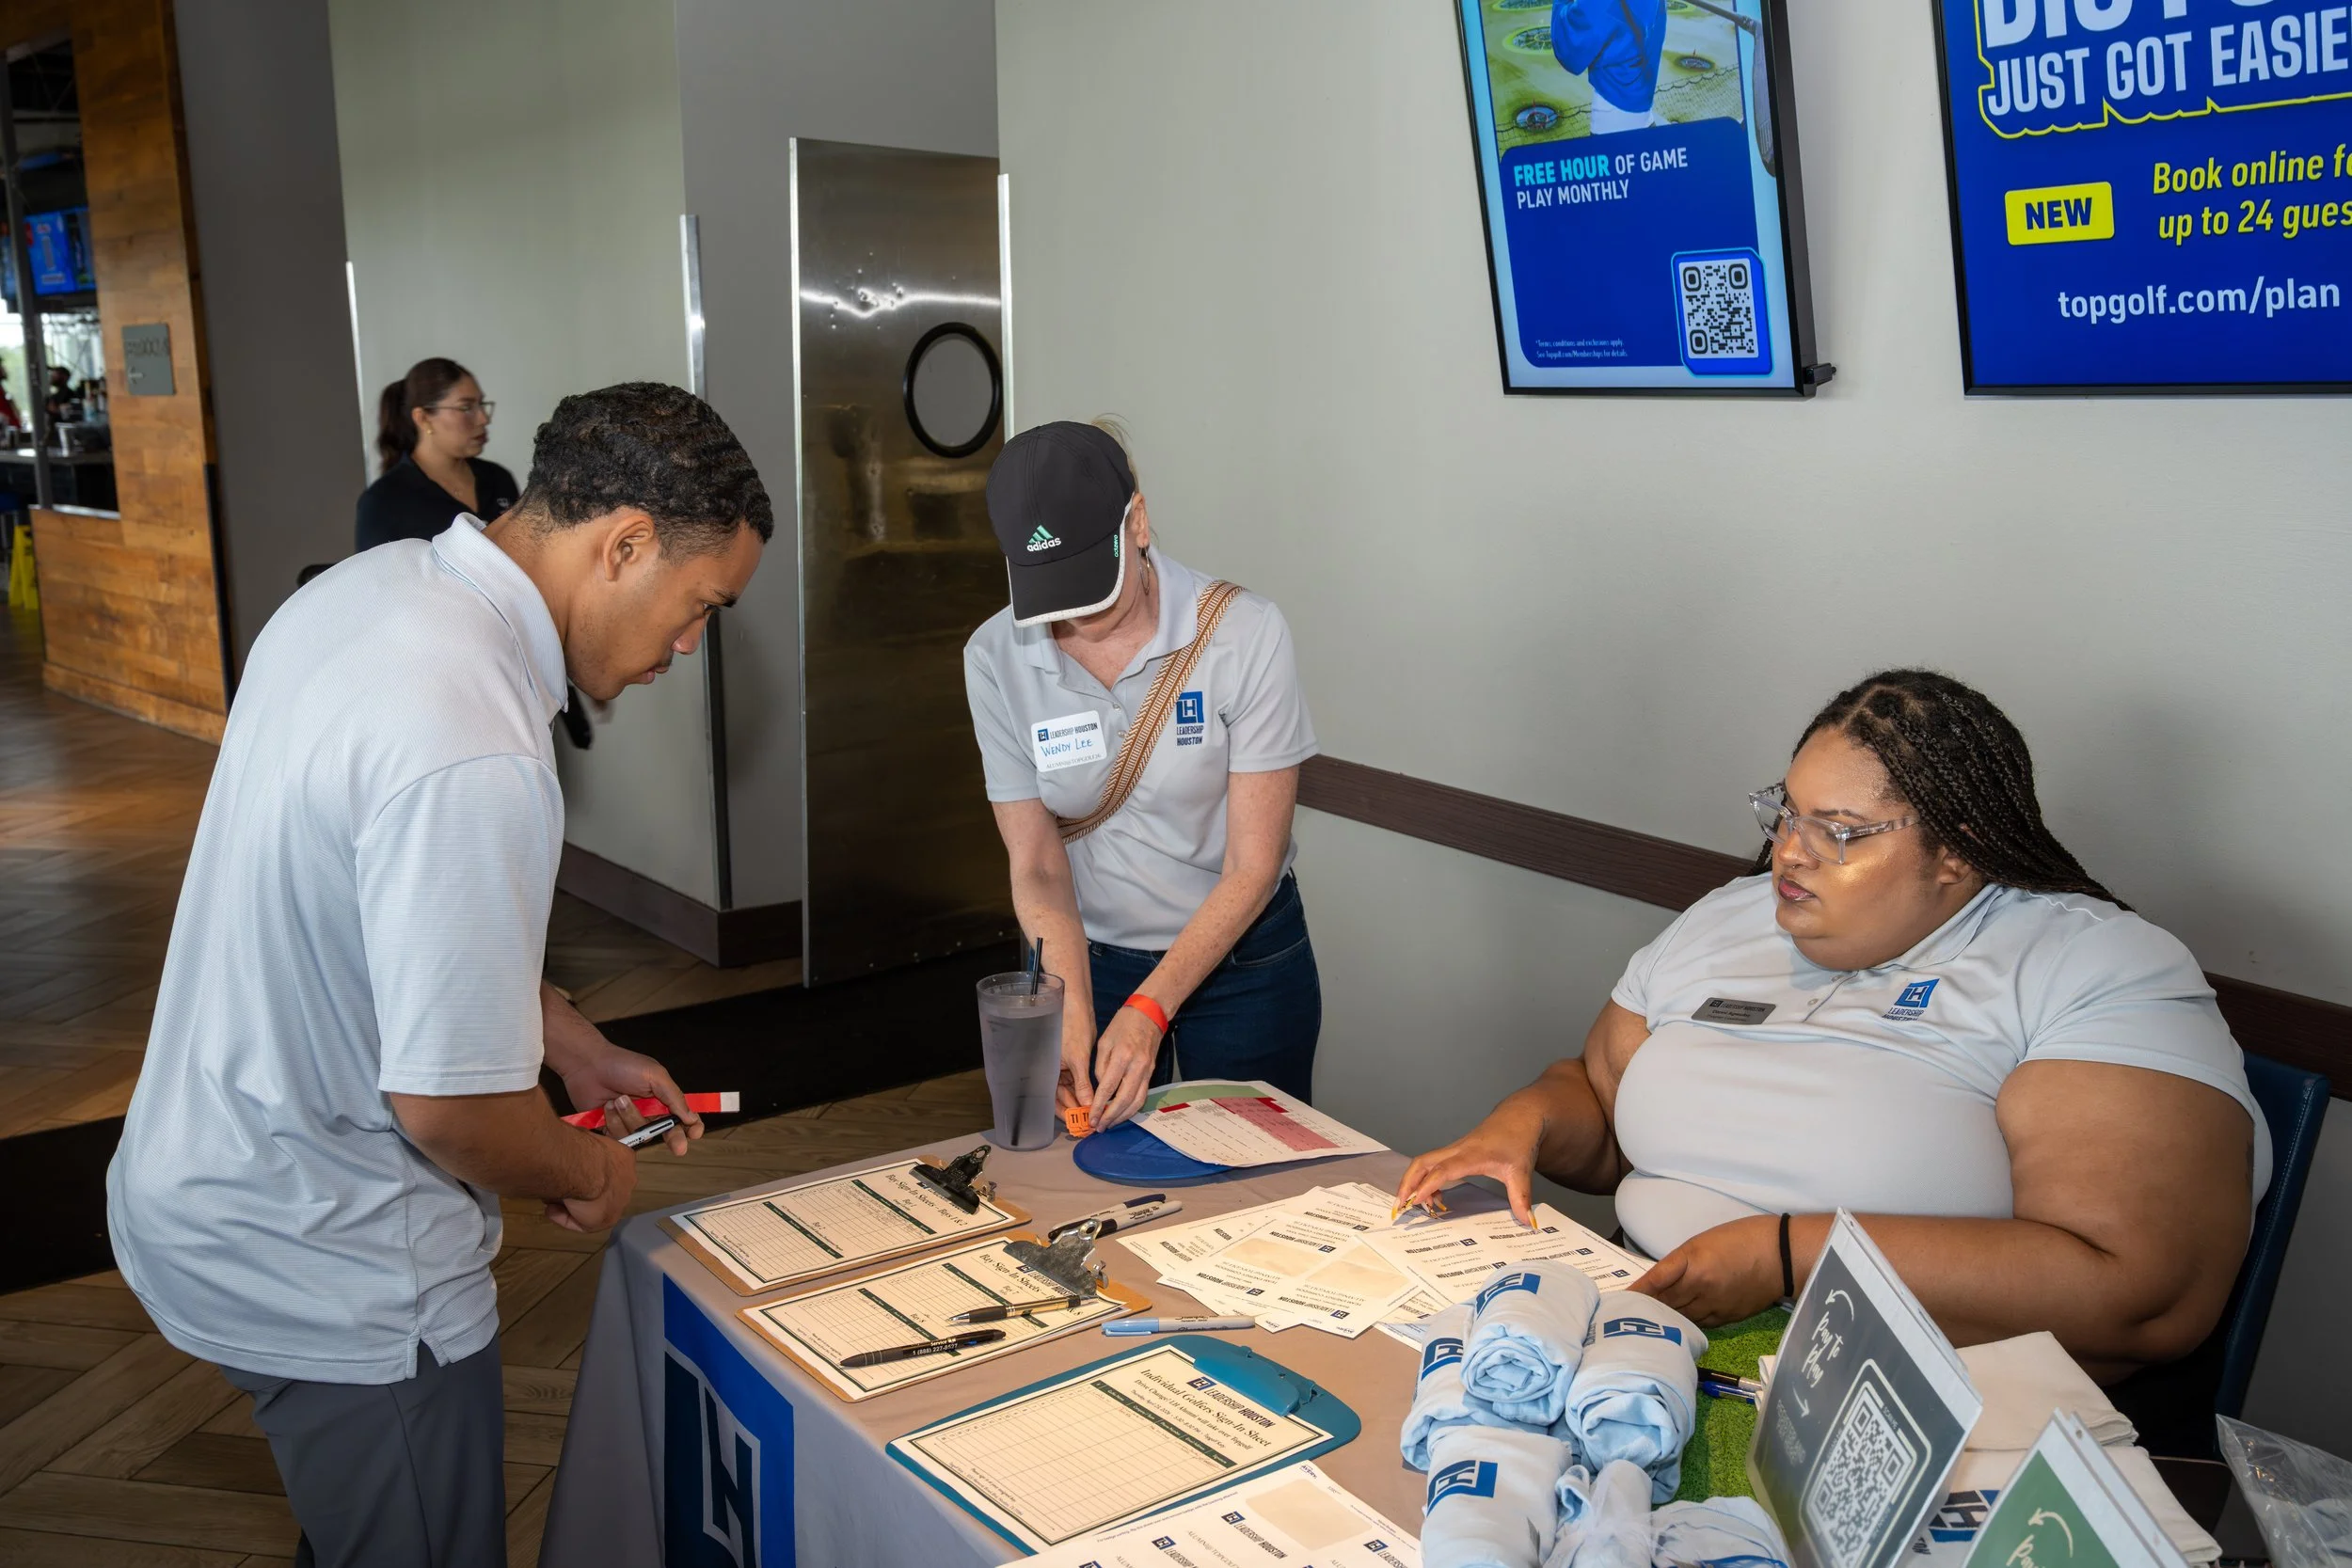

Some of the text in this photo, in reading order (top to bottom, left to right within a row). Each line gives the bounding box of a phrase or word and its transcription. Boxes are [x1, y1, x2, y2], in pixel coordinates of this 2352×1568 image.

[1988, 48, 2090, 117] JUST
[2106, 31, 2192, 101] GOT
[2210, 6, 2352, 87] EASIE
[1514, 148, 1688, 187] FREE HOUR OF GAME
[2153, 157, 2222, 195] Book
[2232, 150, 2324, 187] online
[1517, 179, 1629, 209] PLAY MONTHLY
[2025, 198, 2092, 230] NEW
[2159, 214, 2193, 245] up
[2201, 206, 2229, 235] to
[2238, 199, 2273, 232] 24
[2058, 277, 2340, 325] topgolf.com/plan
[1026, 537, 1061, 552] adidas
[1050, 722, 1098, 739] LEADERSHIP HOUSTON
[1177, 725, 1204, 736] LEADERSHIP
[1041, 742, 1071, 757] WENDY
[1176, 736, 1203, 746] HOUSTON
[1887, 1007, 1925, 1017] LEADERSHIP
[914, 1194, 934, 1207] Sheets
[1303, 1211, 1329, 1221] HOUSTON
[1269, 1230, 1295, 1242] HOUSTON
[978, 1253, 994, 1263] Bay
[992, 1261, 1019, 1278] Sign-In
[1016, 1276, 1041, 1291] Sheets
[1027, 1271, 1057, 1287] LEADERSHIP
[1196, 1272, 1223, 1285] HOUSTON
[1436, 1270, 1465, 1279] HOUSTON
[1278, 1296, 1307, 1307] HOUSTON
[1134, 1379, 1149, 1389] Drive
[1179, 1405, 1199, 1418] Alumni
[1206, 1422, 1218, 1431] take
[1230, 1435, 1252, 1449] Topgolf
[1140, 1369, 1271, 1446] Individual Golfers Sign-In Sheet
[1203, 1388, 1275, 1428] LEADERSHIP HOUSTON
[1233, 1523, 1287, 1559] LEADERSHIP HOUSTON
[1163, 1547, 1194, 1568] LEADERSHIP
